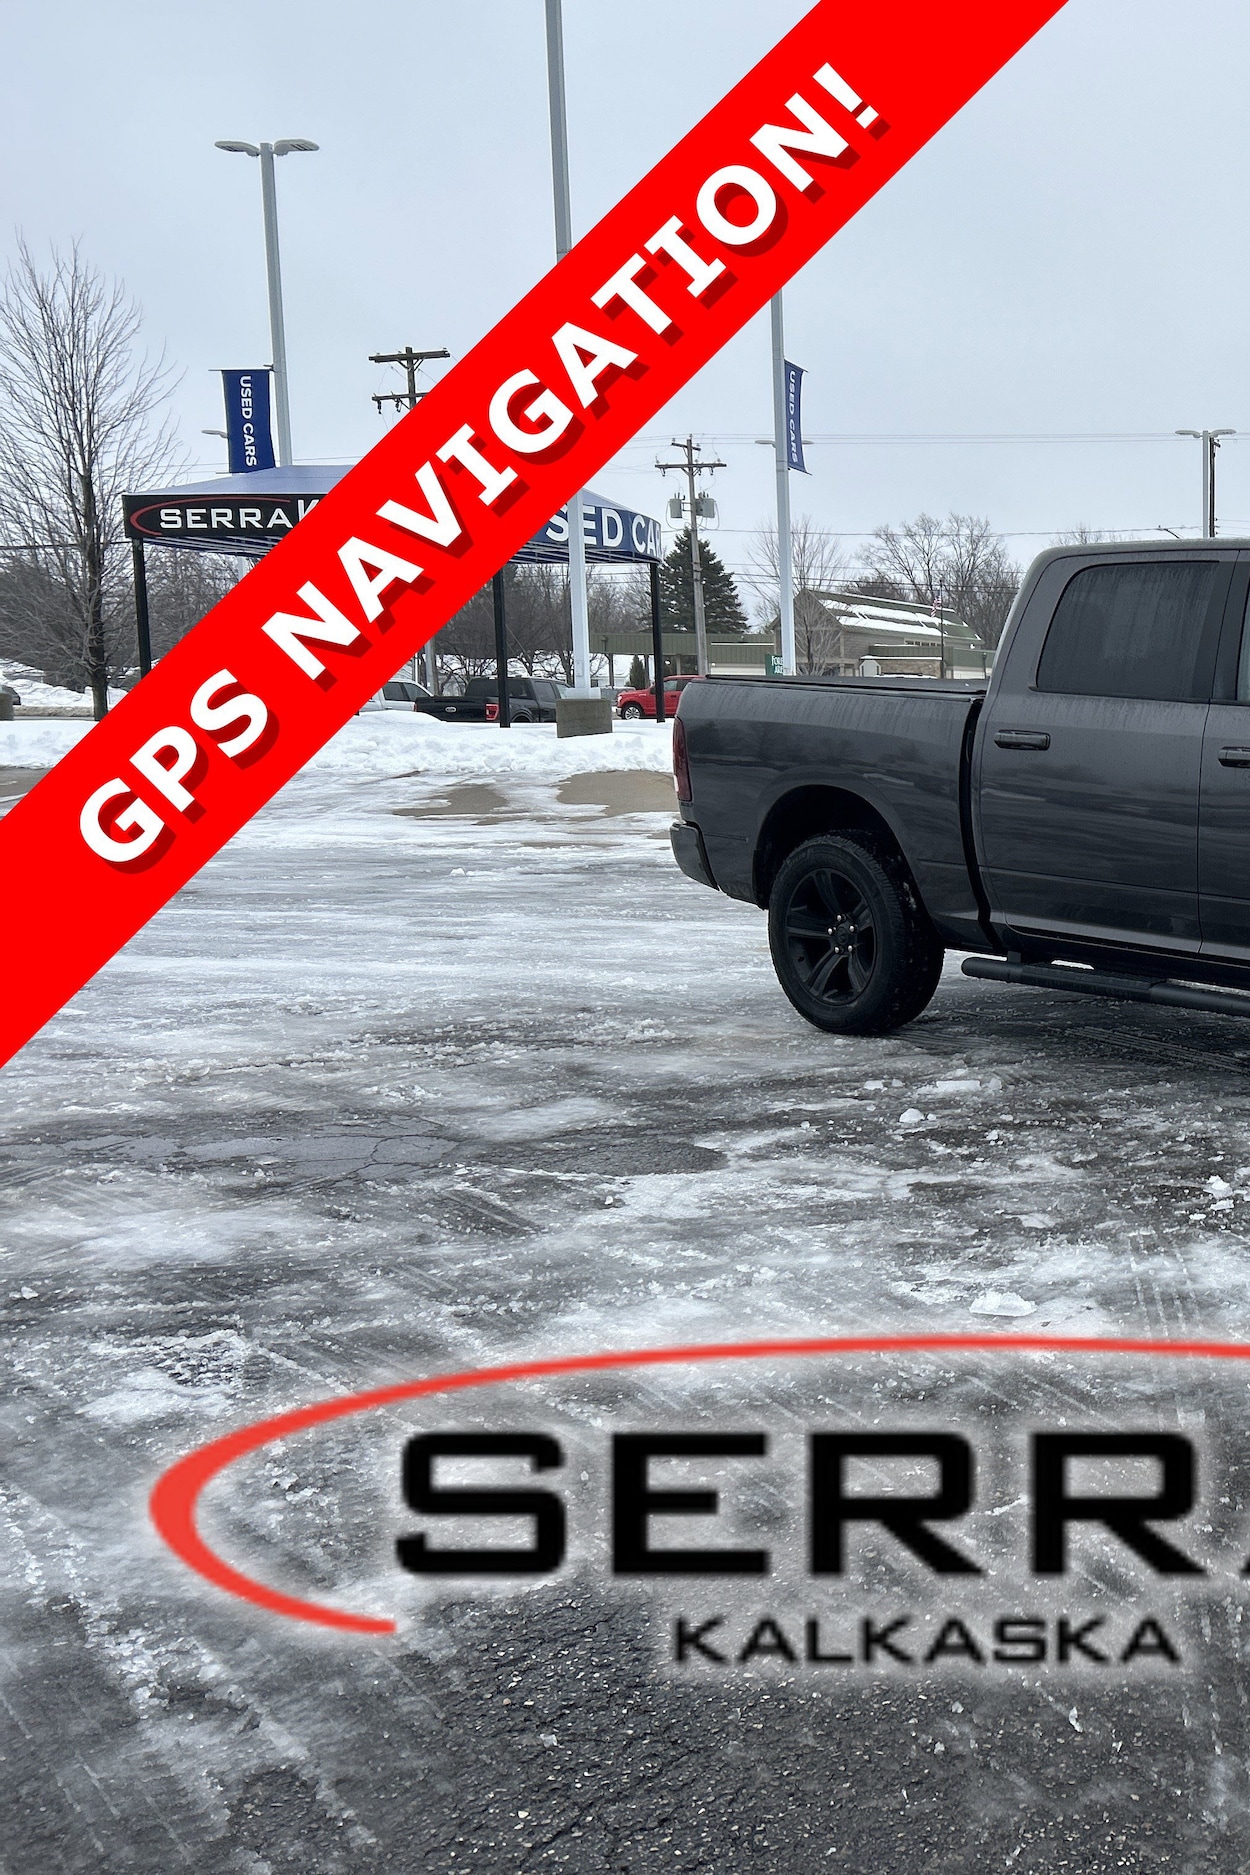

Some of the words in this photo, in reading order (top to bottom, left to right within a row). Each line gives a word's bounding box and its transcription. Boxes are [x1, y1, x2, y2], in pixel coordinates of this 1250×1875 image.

[240, 375, 253, 419] USED
[243, 422, 257, 467] CARS
[789, 419, 798, 463] CARS
[160, 508, 294, 529] SERRA
